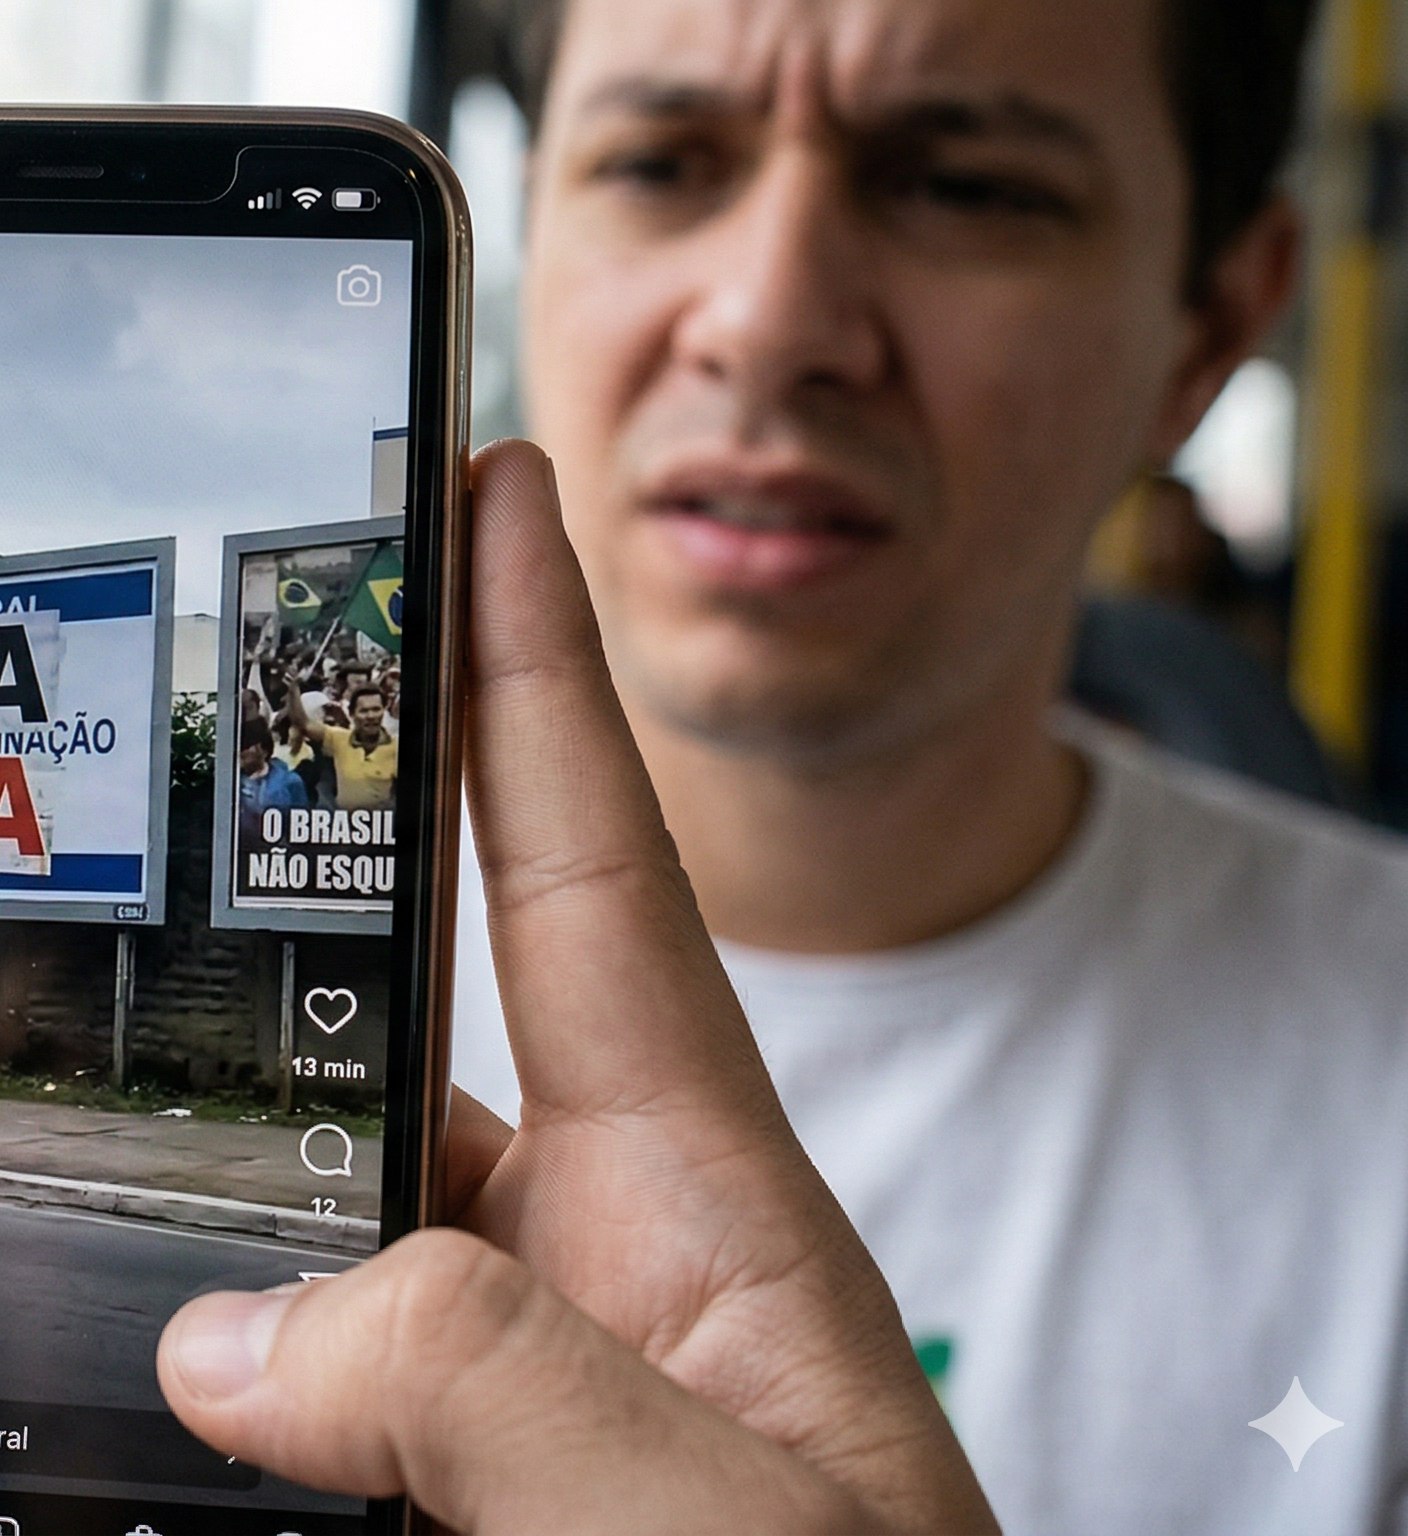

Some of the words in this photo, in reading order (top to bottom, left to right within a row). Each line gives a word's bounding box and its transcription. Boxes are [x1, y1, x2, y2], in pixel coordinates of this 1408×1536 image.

[262, 808, 282, 843] O
[289, 808, 396, 845] BRASIL
[249, 847, 308, 889] NÃO
[316, 854, 395, 894] ESQU
[292, 1056, 317, 1076] 13
[324, 1059, 366, 1079] min
[311, 1197, 337, 1217] 12
